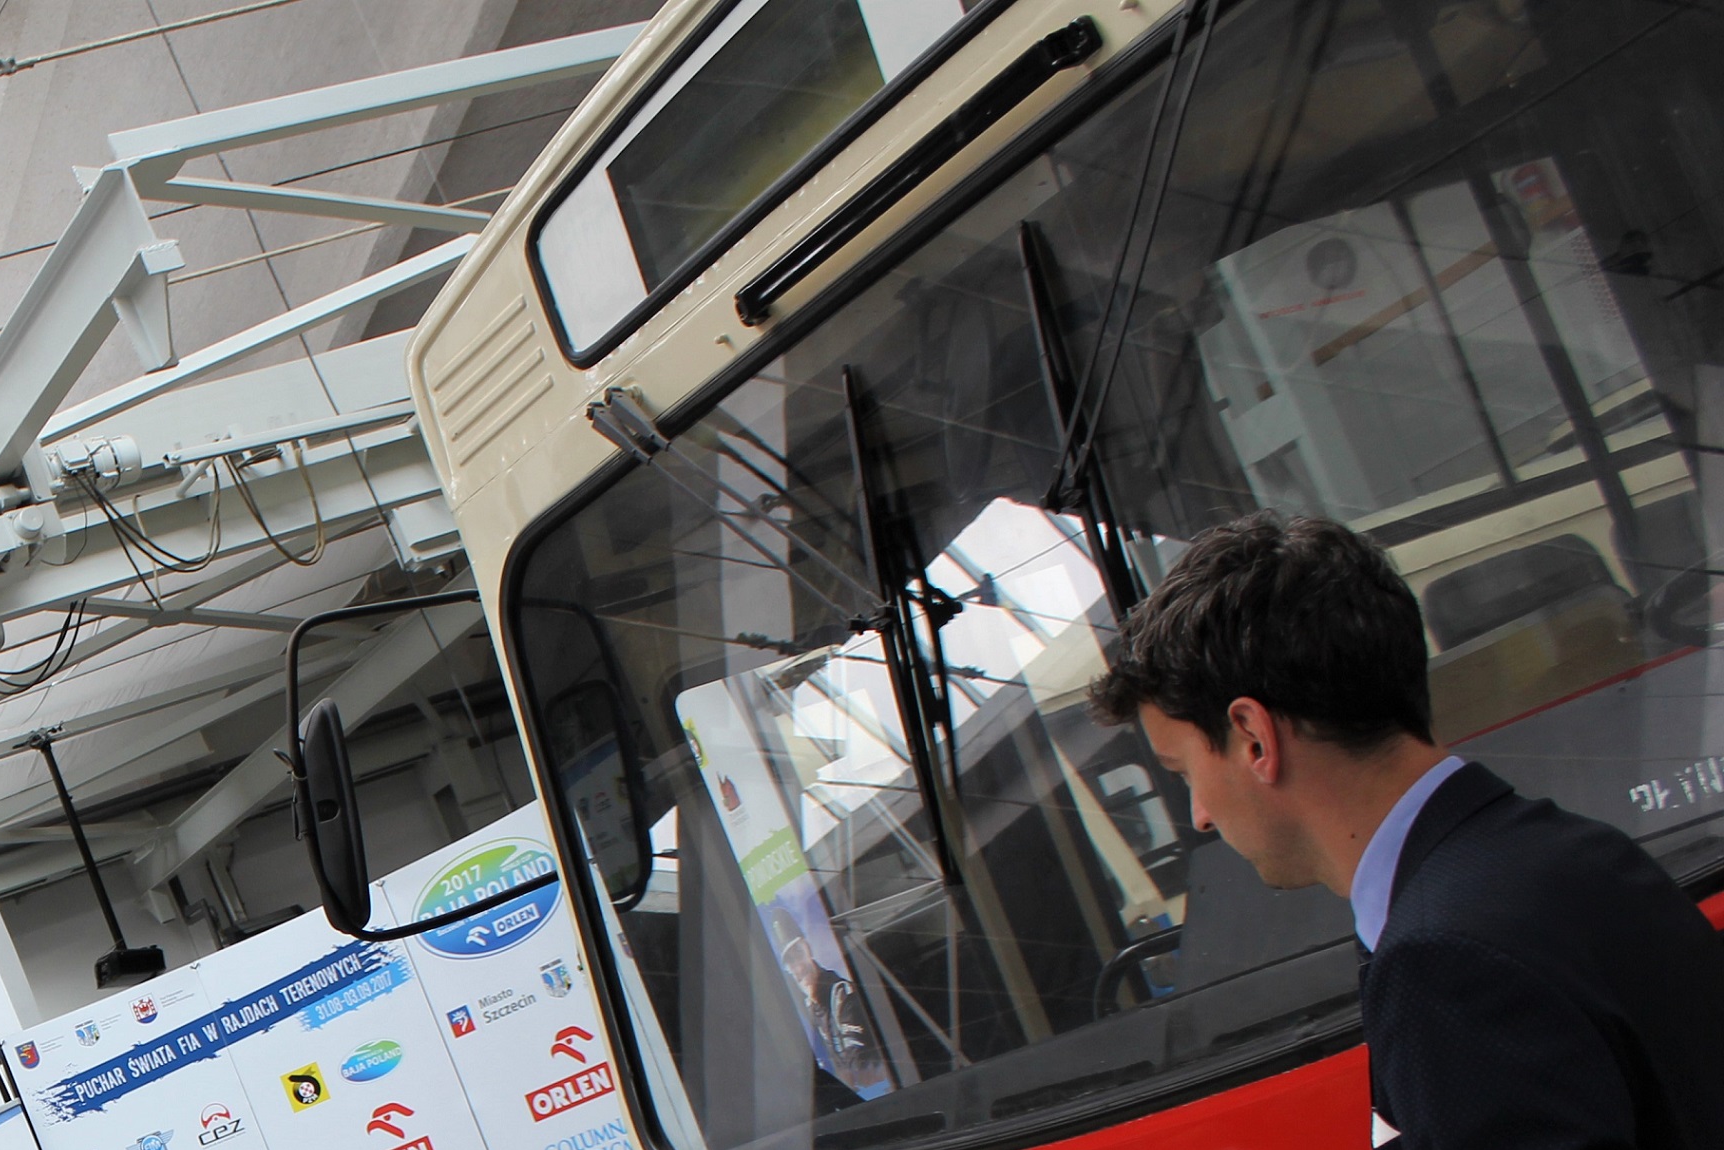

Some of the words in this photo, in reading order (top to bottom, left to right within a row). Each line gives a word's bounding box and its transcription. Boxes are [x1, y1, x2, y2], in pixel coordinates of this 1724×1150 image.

[440, 864, 481, 896] 2017
[496, 906, 536, 933] ORLEN
[315, 970, 393, 1021] 31.08-03.09.2017
[478, 987, 513, 1009] Miasto
[482, 993, 537, 1024] Szczecin
[75, 1067, 126, 1102] PUCHAR
[127, 1044, 177, 1079] ŚWIATA
[177, 1032, 202, 1055] FIA
[201, 1022, 219, 1043] W
[220, 994, 280, 1035] RAJDACH
[279, 953, 363, 1006] TERENOWYCH
[342, 1062, 367, 1078] BAJA
[367, 1047, 403, 1069] POLAND
[532, 1067, 612, 1115] ORLEN
